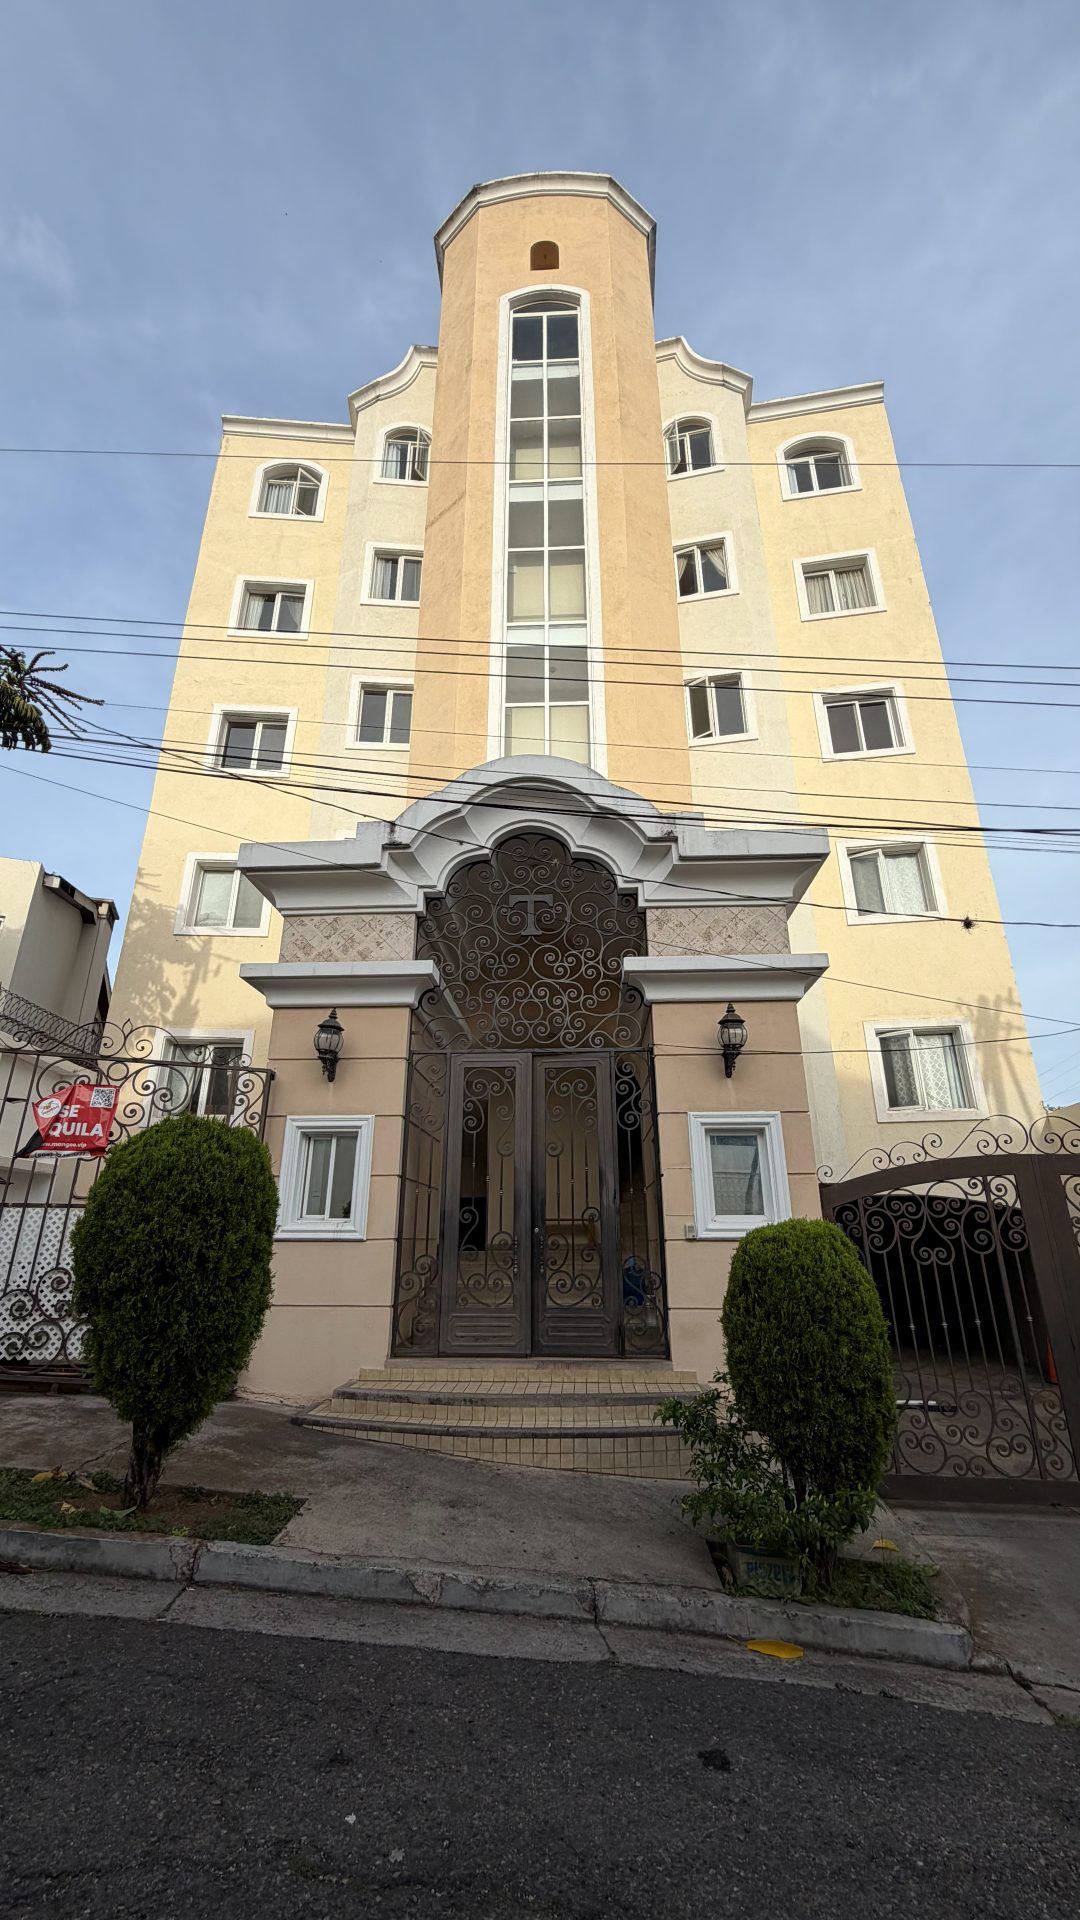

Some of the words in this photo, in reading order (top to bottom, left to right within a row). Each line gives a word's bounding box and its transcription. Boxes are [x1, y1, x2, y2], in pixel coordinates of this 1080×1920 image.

[509, 894, 553, 936] T
[59, 1104, 80, 1118] SE
[48, 1122, 103, 1137] QUILA
